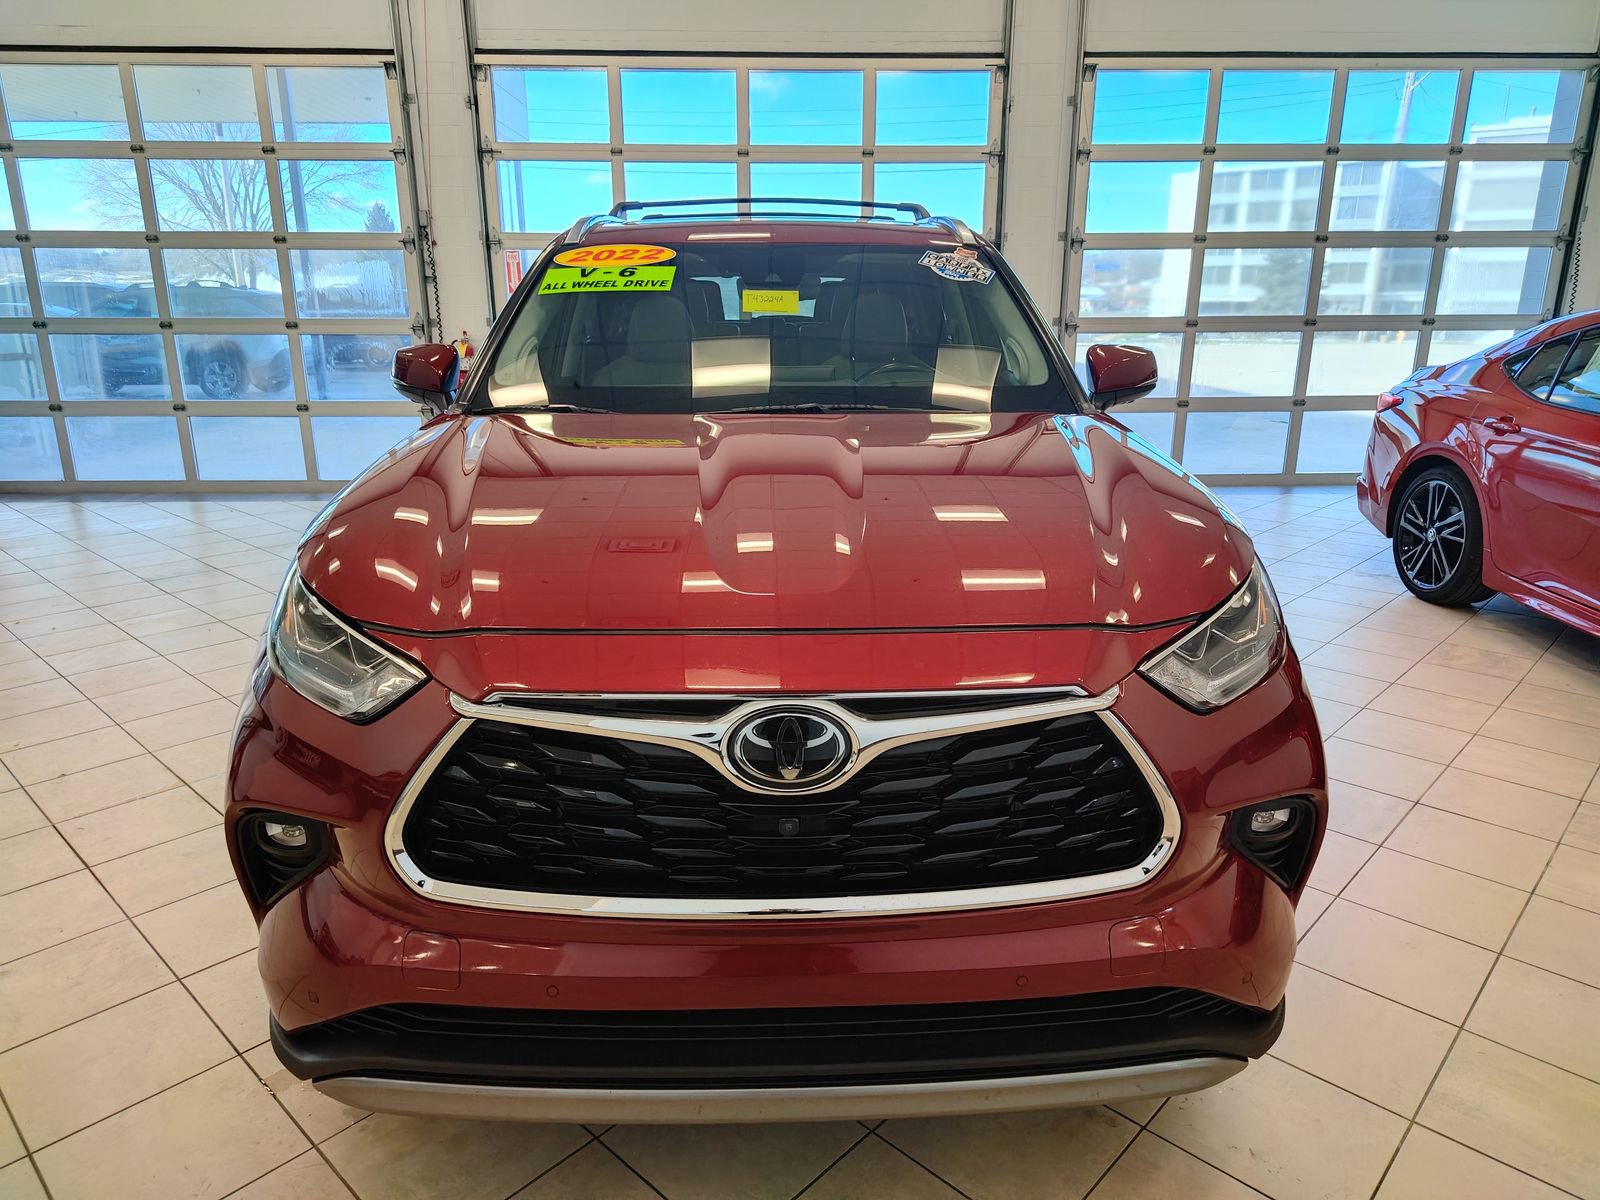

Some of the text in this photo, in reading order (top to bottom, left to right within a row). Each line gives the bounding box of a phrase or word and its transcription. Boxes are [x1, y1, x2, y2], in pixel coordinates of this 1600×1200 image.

[567, 248, 665, 263] 2022
[928, 253, 988, 276] CARFAX
[934, 261, 987, 281] OWNER
[542, 279, 670, 291] ALL WHEEL DRIVE
